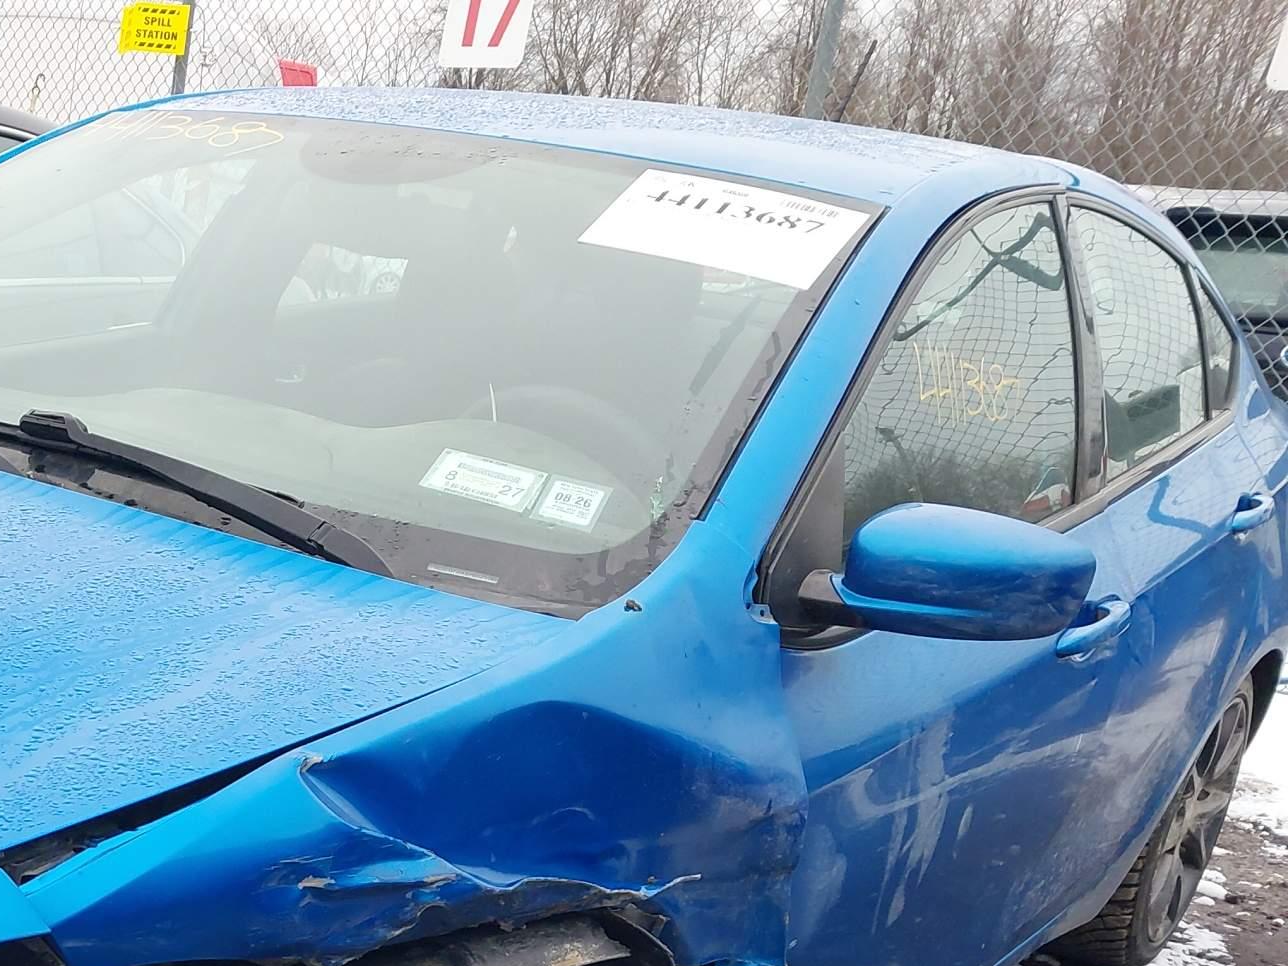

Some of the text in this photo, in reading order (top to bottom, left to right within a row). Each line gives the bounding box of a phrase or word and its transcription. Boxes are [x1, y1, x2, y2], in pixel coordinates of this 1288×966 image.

[143, 15, 173, 28] SPILL
[135, 28, 178, 41] STATION
[647, 190, 825, 233] 44113687
[498, 484, 525, 498] 27
[554, 491, 593, 508] 08 26
